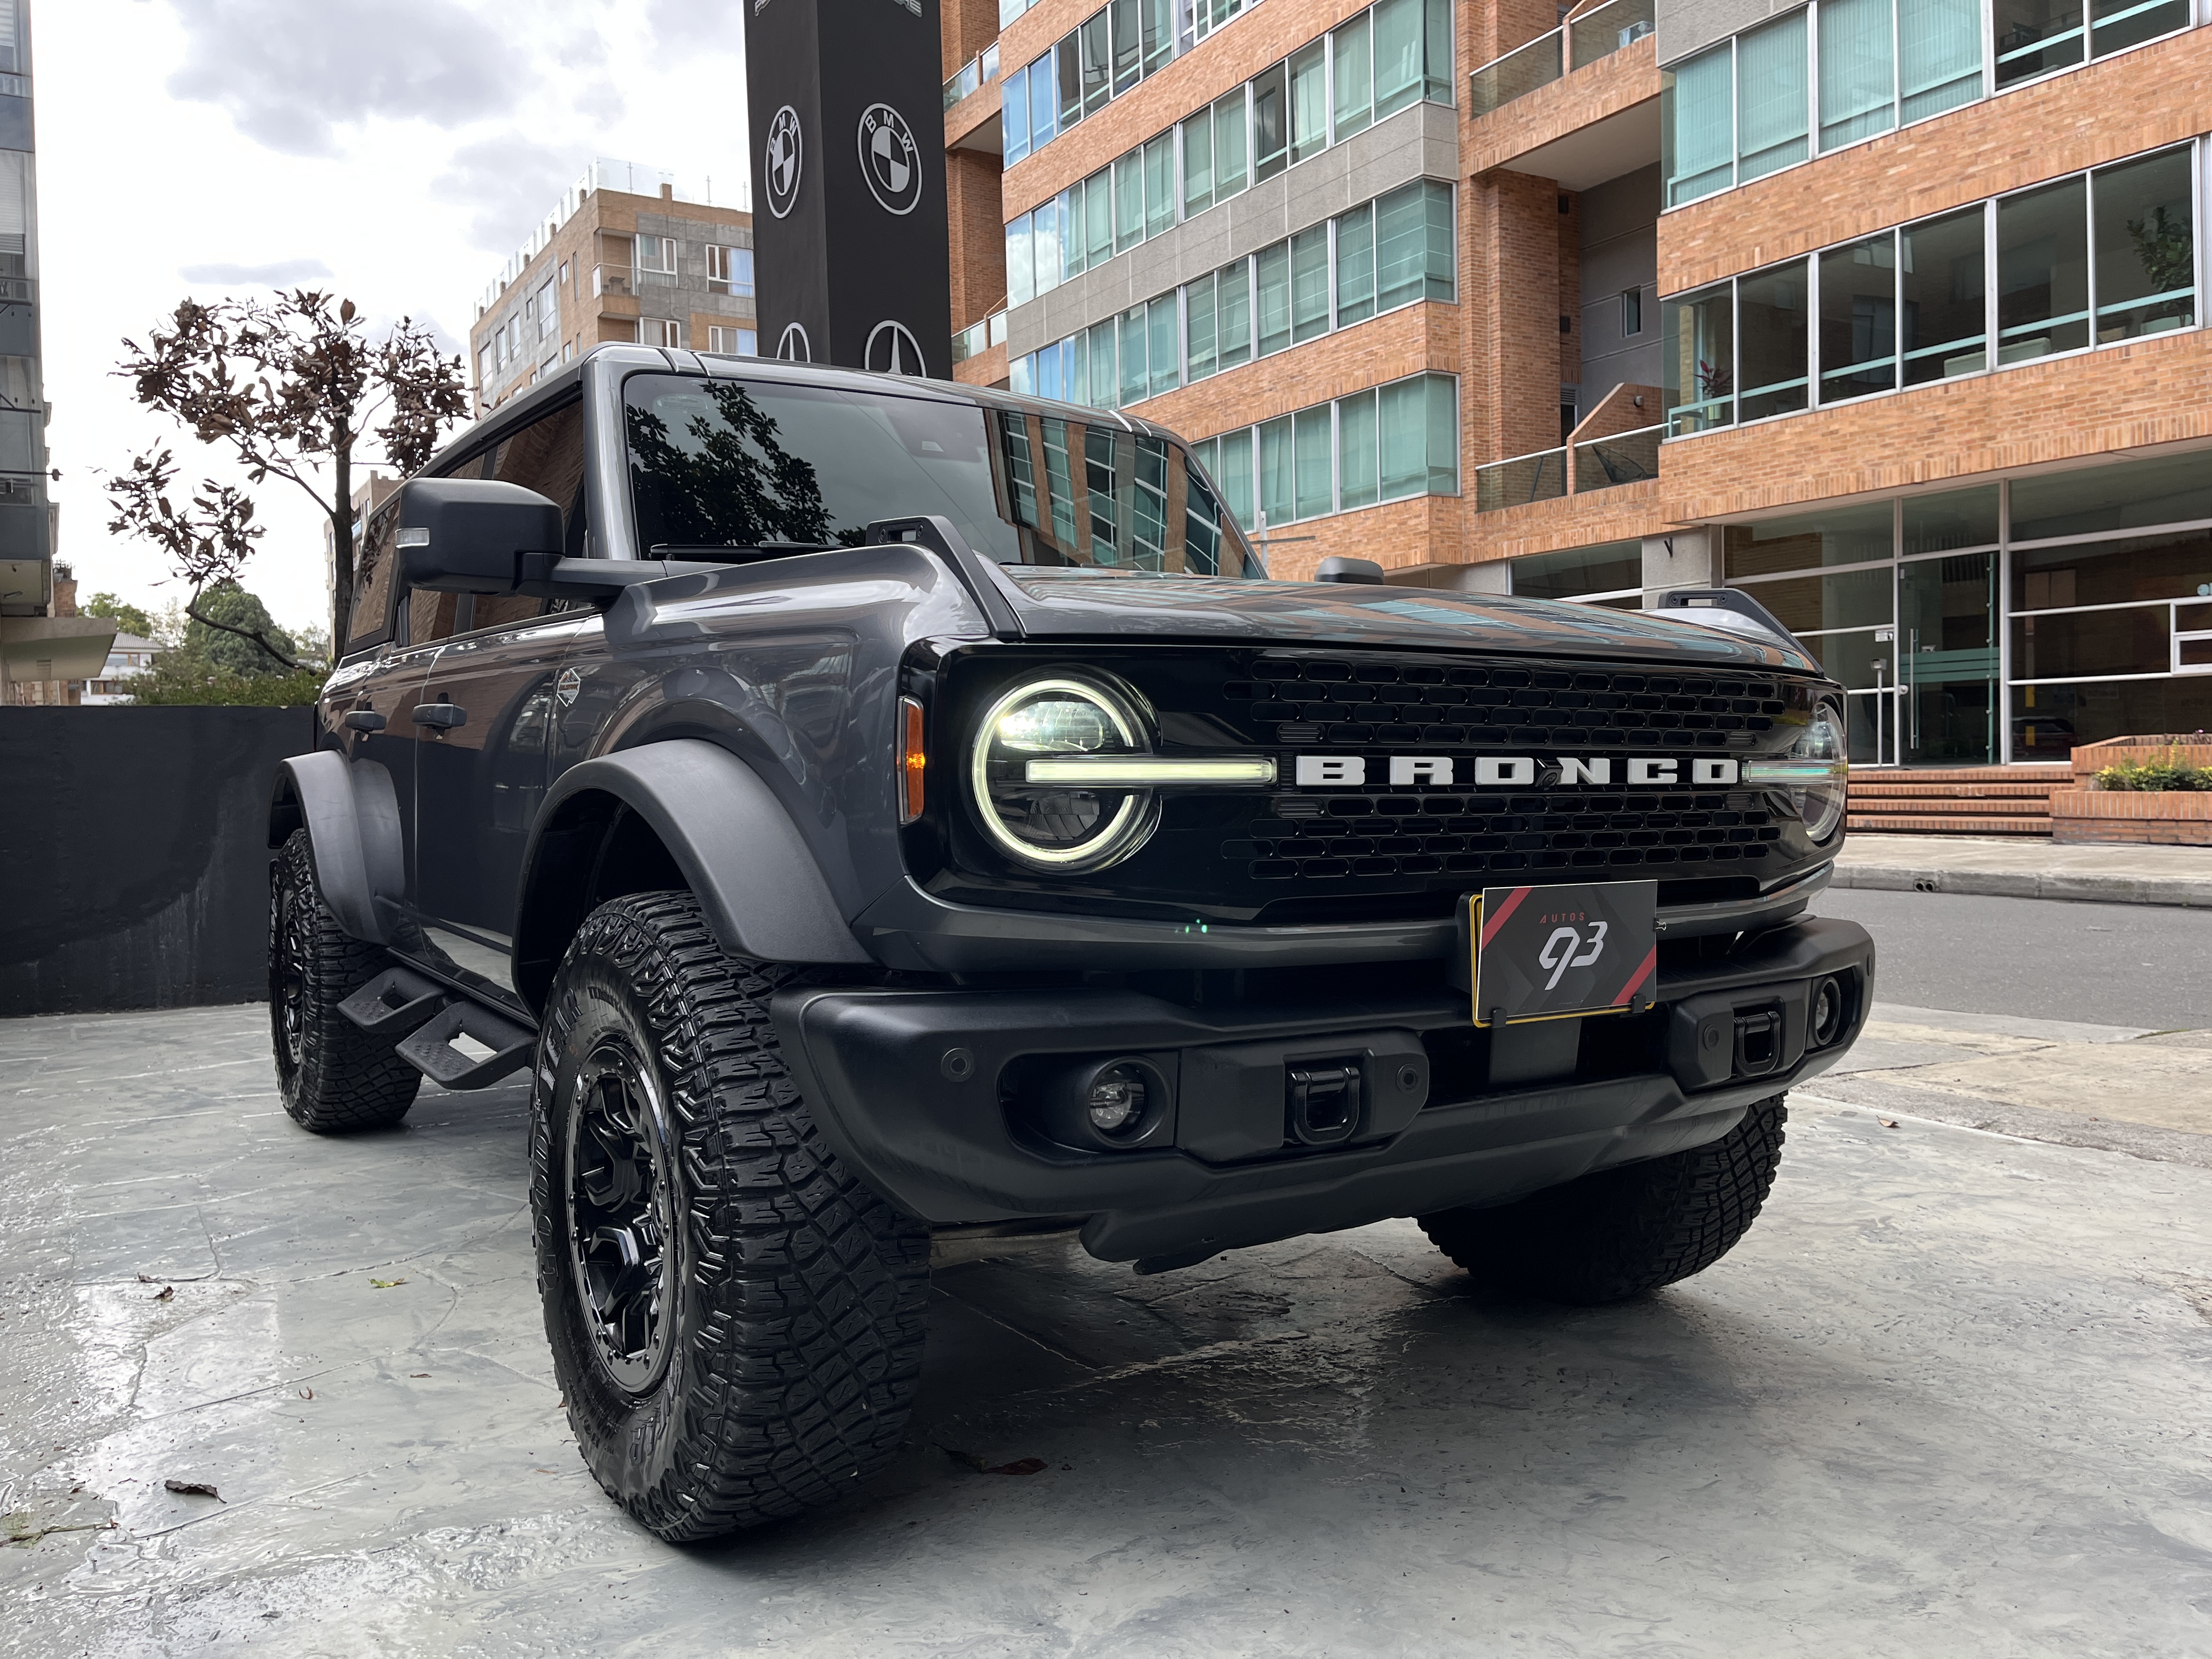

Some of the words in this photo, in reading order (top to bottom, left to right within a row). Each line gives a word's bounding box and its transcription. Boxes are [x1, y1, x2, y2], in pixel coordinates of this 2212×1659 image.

[770, 113, 798, 155] BMW
[865, 110, 913, 153] BMW
[1296, 755, 1739, 786] BRONCO
[1539, 912, 1585, 923] AUTOS
[1539, 921, 1608, 991] 93
[534, 988, 583, 1290] GOODYEAR
